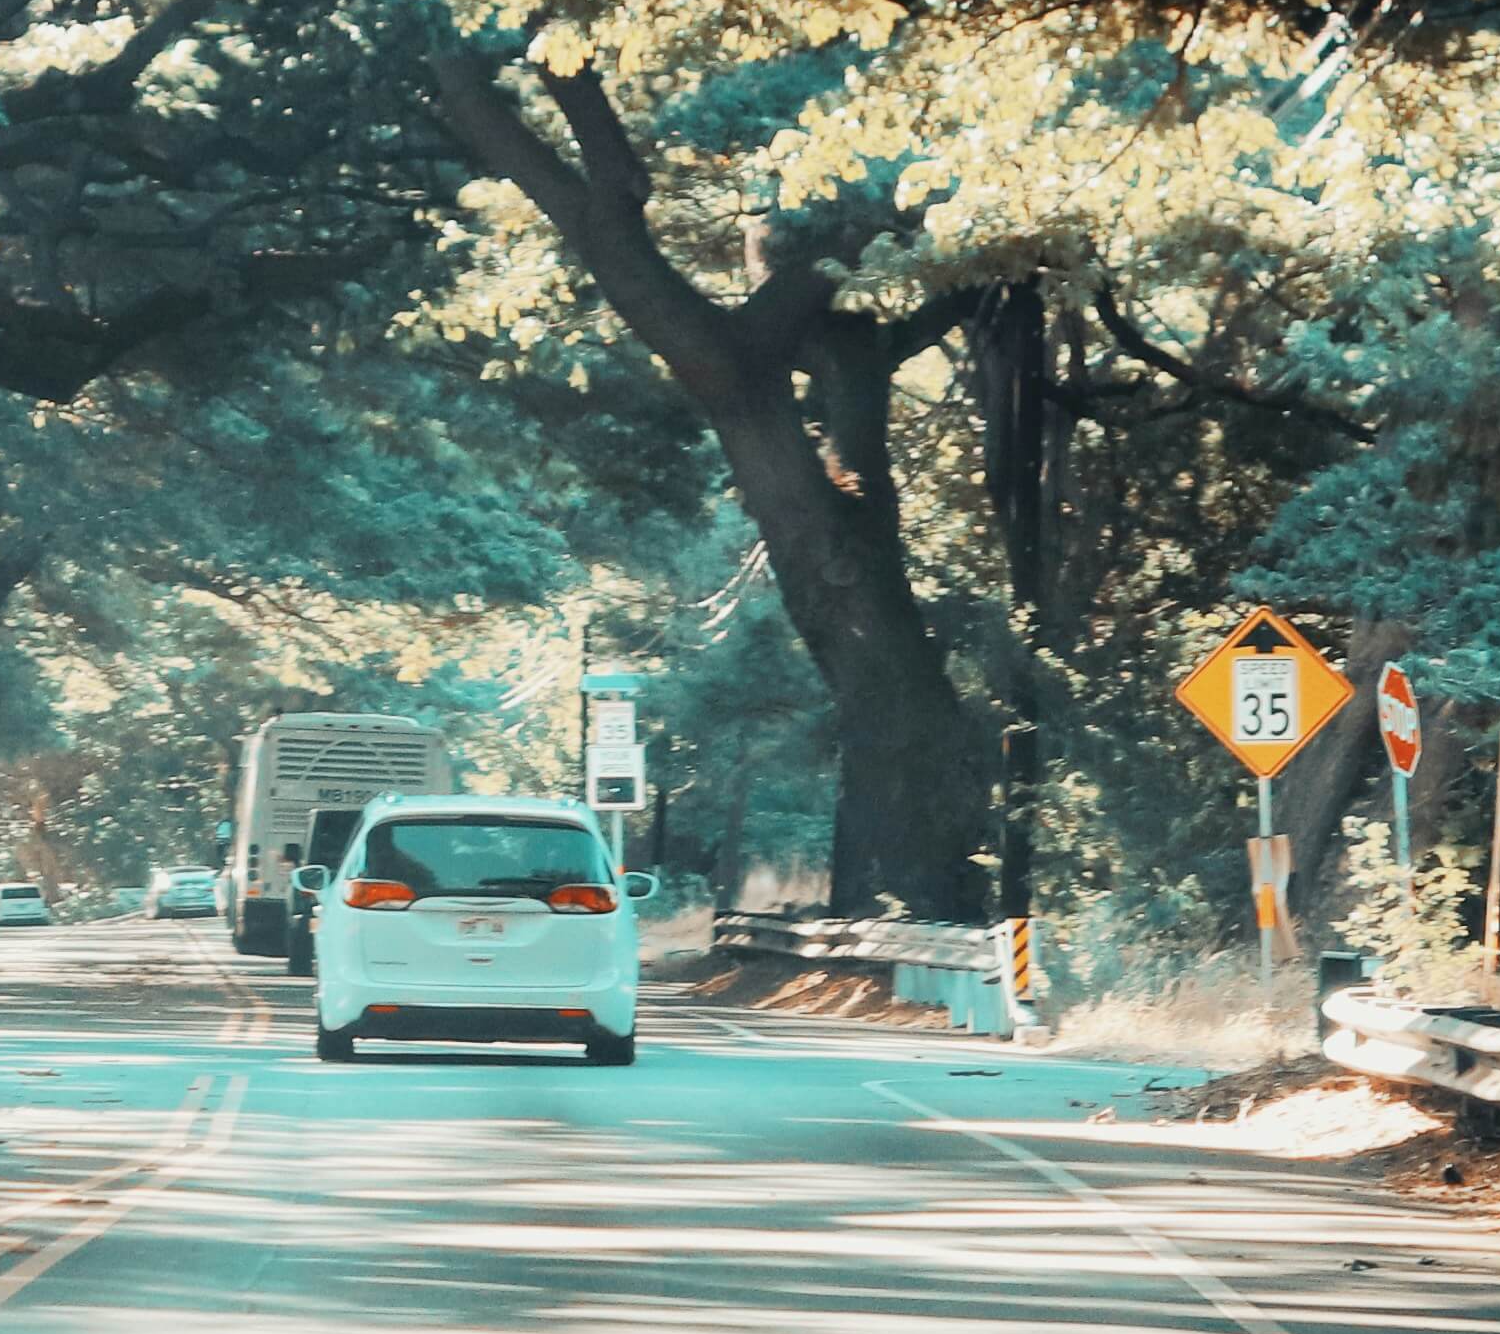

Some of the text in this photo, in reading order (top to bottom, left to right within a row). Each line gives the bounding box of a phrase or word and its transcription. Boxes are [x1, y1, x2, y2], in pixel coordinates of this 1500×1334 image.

[1240, 662, 1289, 675] SPEED
[1241, 692, 1290, 737] 35
[1382, 694, 1417, 744] STOP
[601, 723, 629, 740] 35
